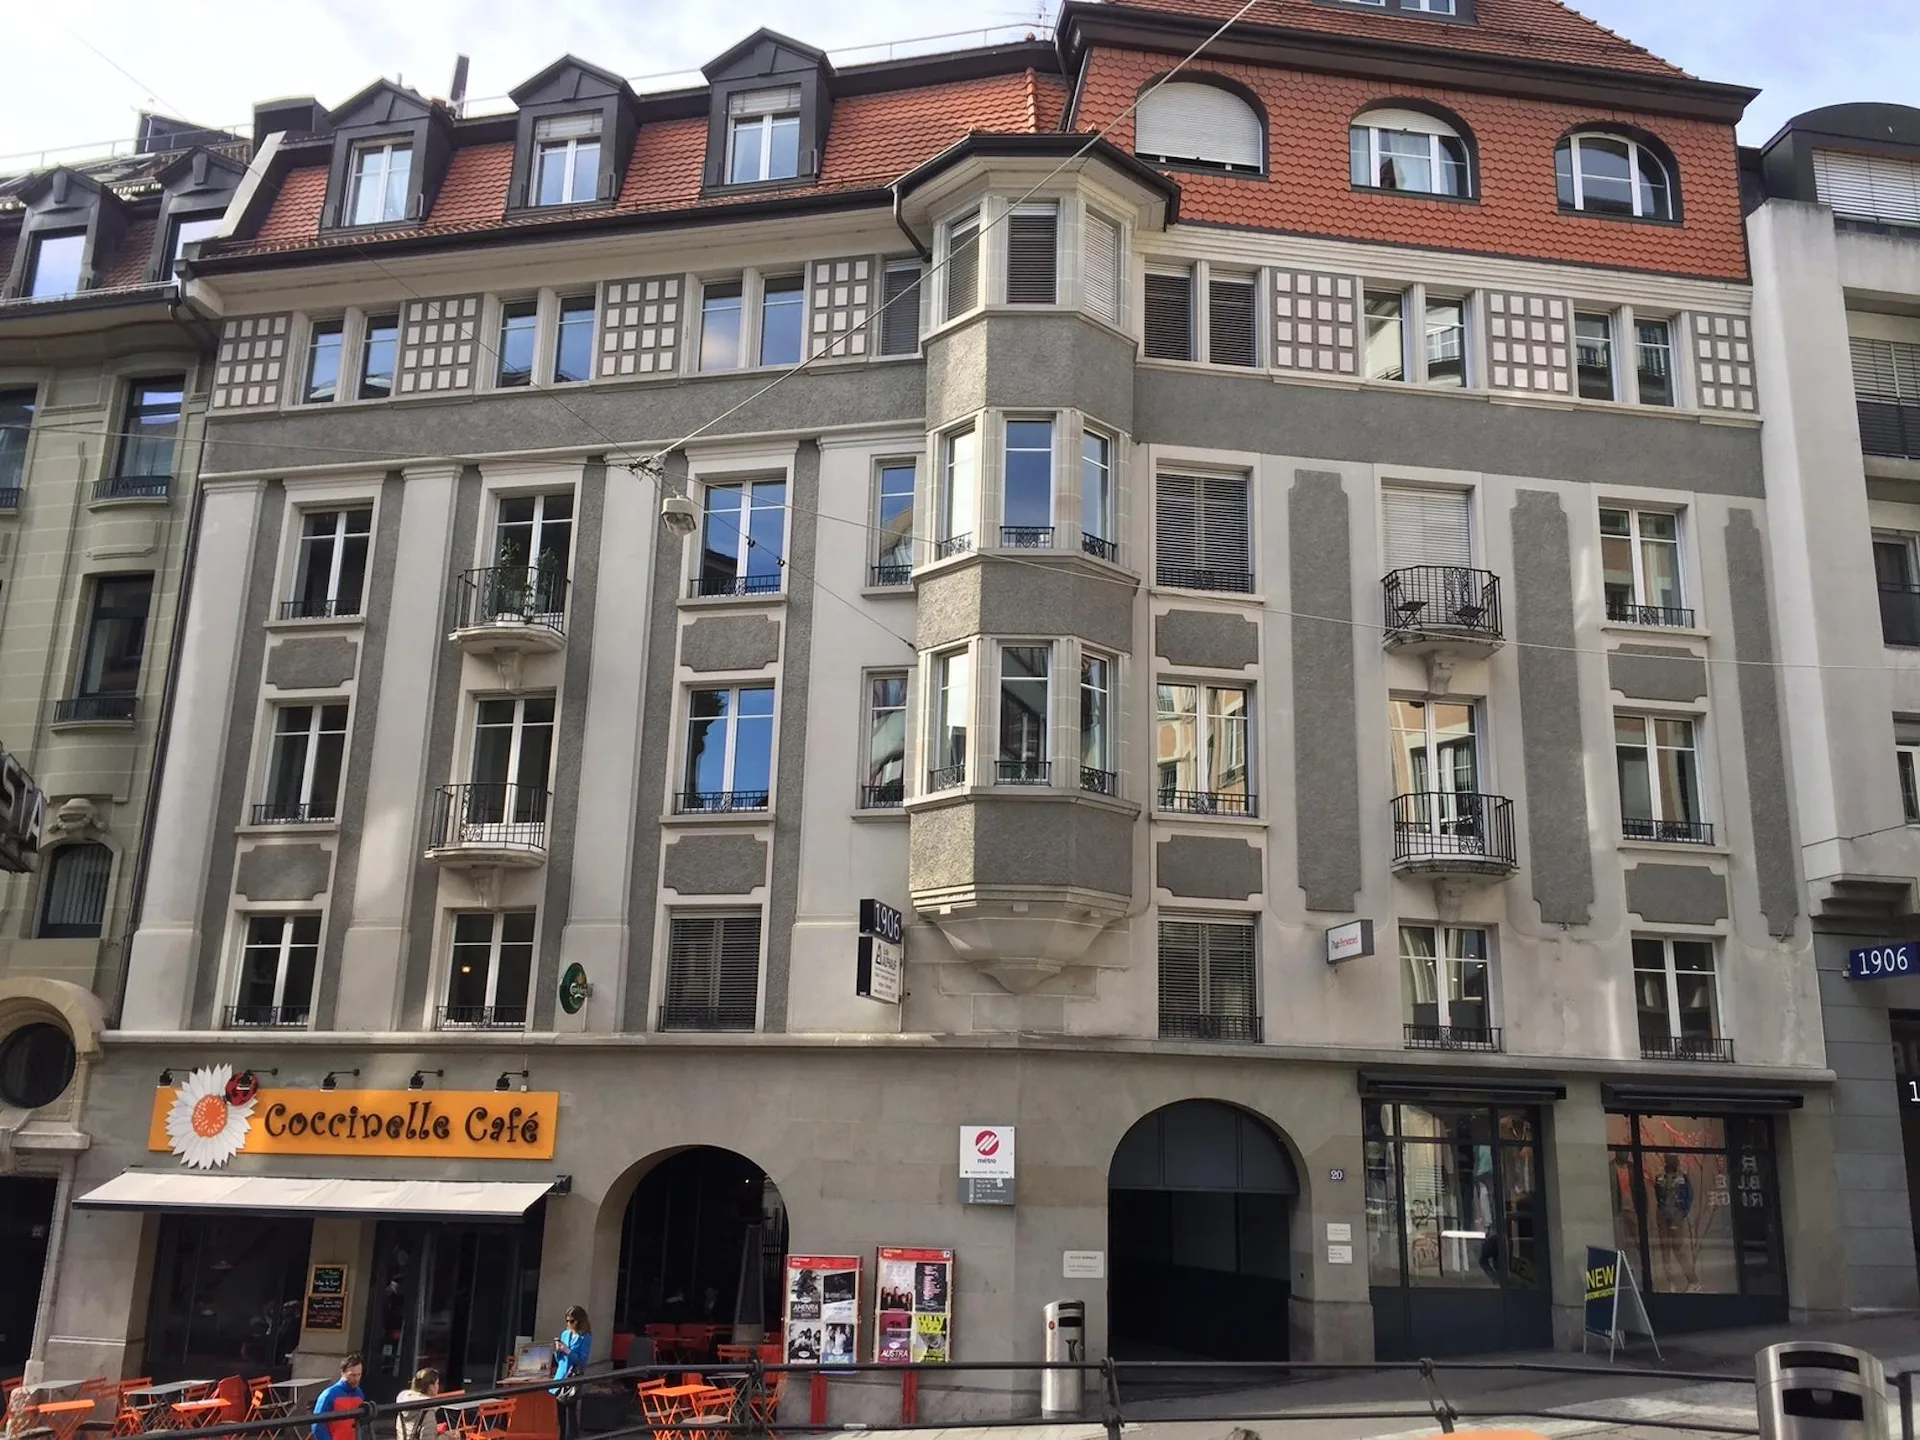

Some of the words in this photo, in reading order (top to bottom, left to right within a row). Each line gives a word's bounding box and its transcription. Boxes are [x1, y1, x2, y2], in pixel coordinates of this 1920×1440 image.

[876, 903, 901, 941] 1906
[1858, 946, 1909, 976] 1906
[264, 1101, 450, 1140] Coccinelle
[465, 1106, 540, 1143] Café
[1330, 1170, 1344, 1180] 20
[1585, 1265, 1615, 1290] NEW
[881, 1349, 908, 1358] AUSTRA
